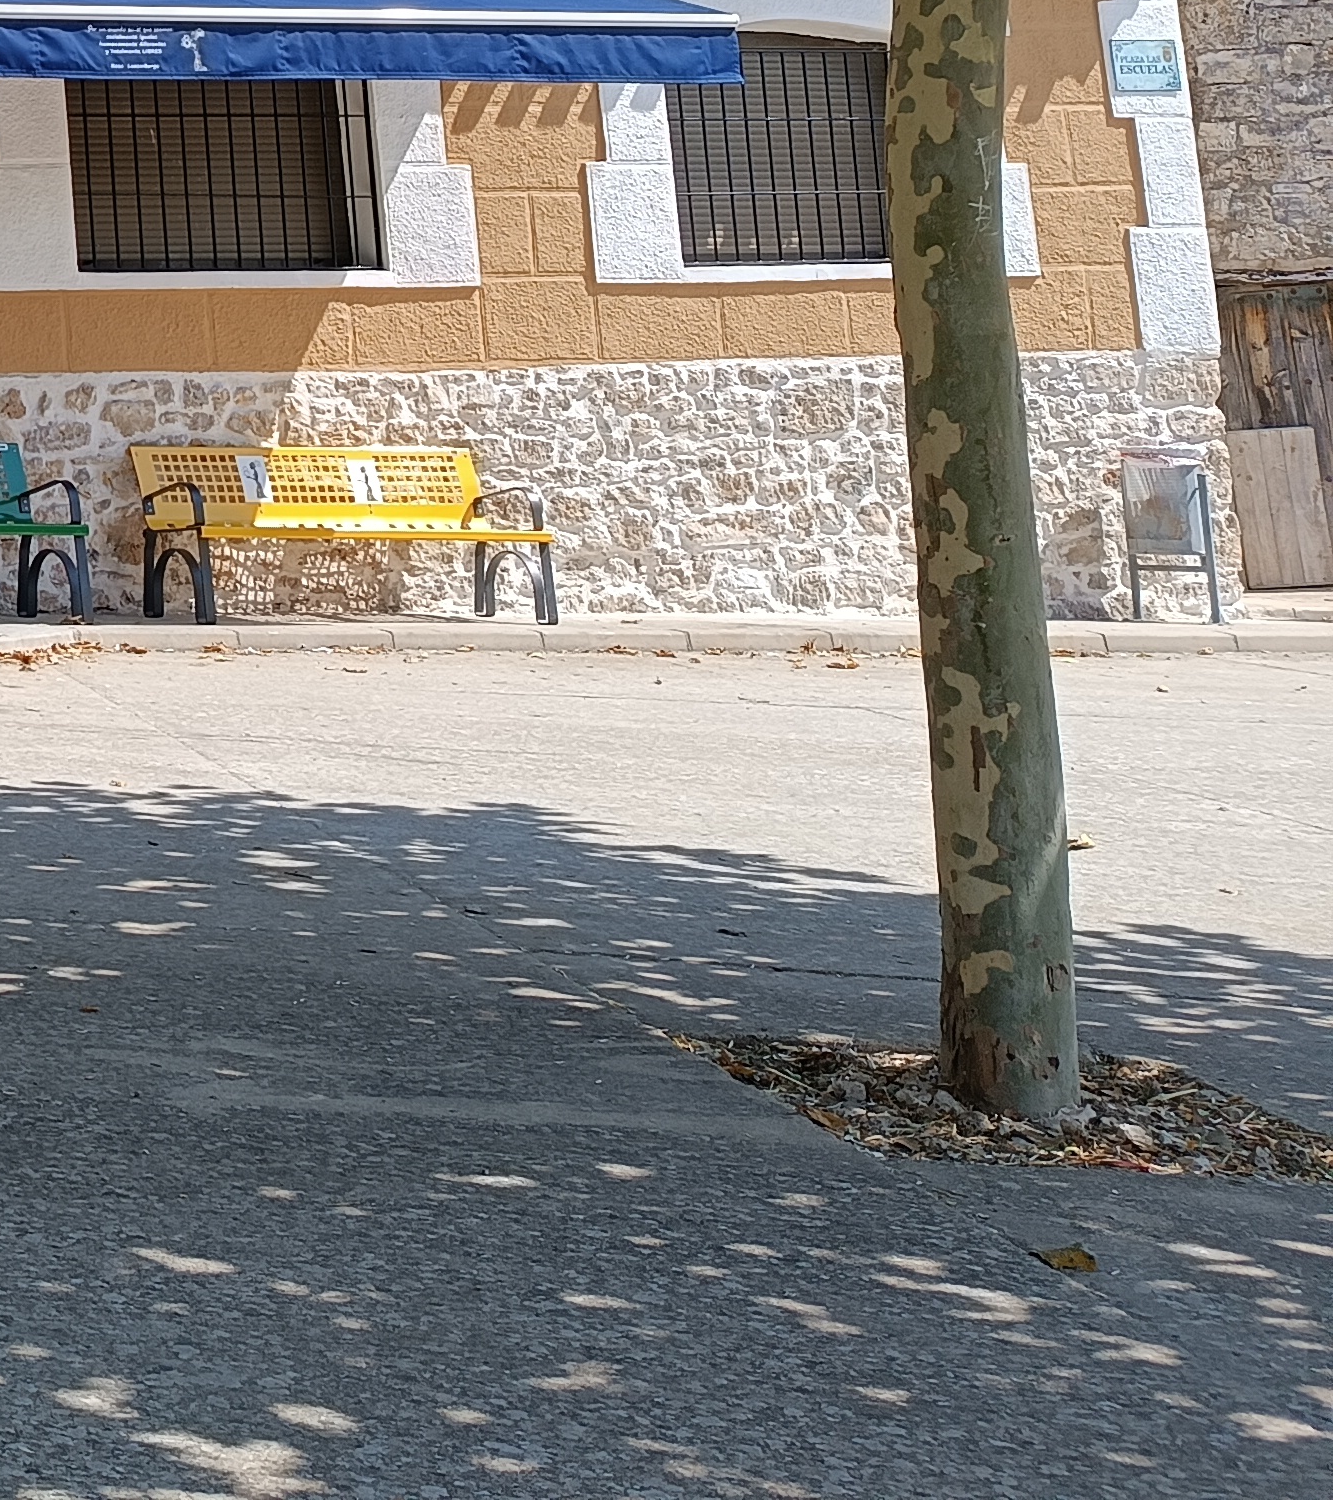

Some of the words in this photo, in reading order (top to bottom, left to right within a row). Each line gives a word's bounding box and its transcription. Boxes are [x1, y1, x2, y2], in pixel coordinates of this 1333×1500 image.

[1120, 55, 1145, 63] PLAZA
[1146, 55, 1161, 63] LAS
[1120, 65, 1174, 74] ESCUELAS
